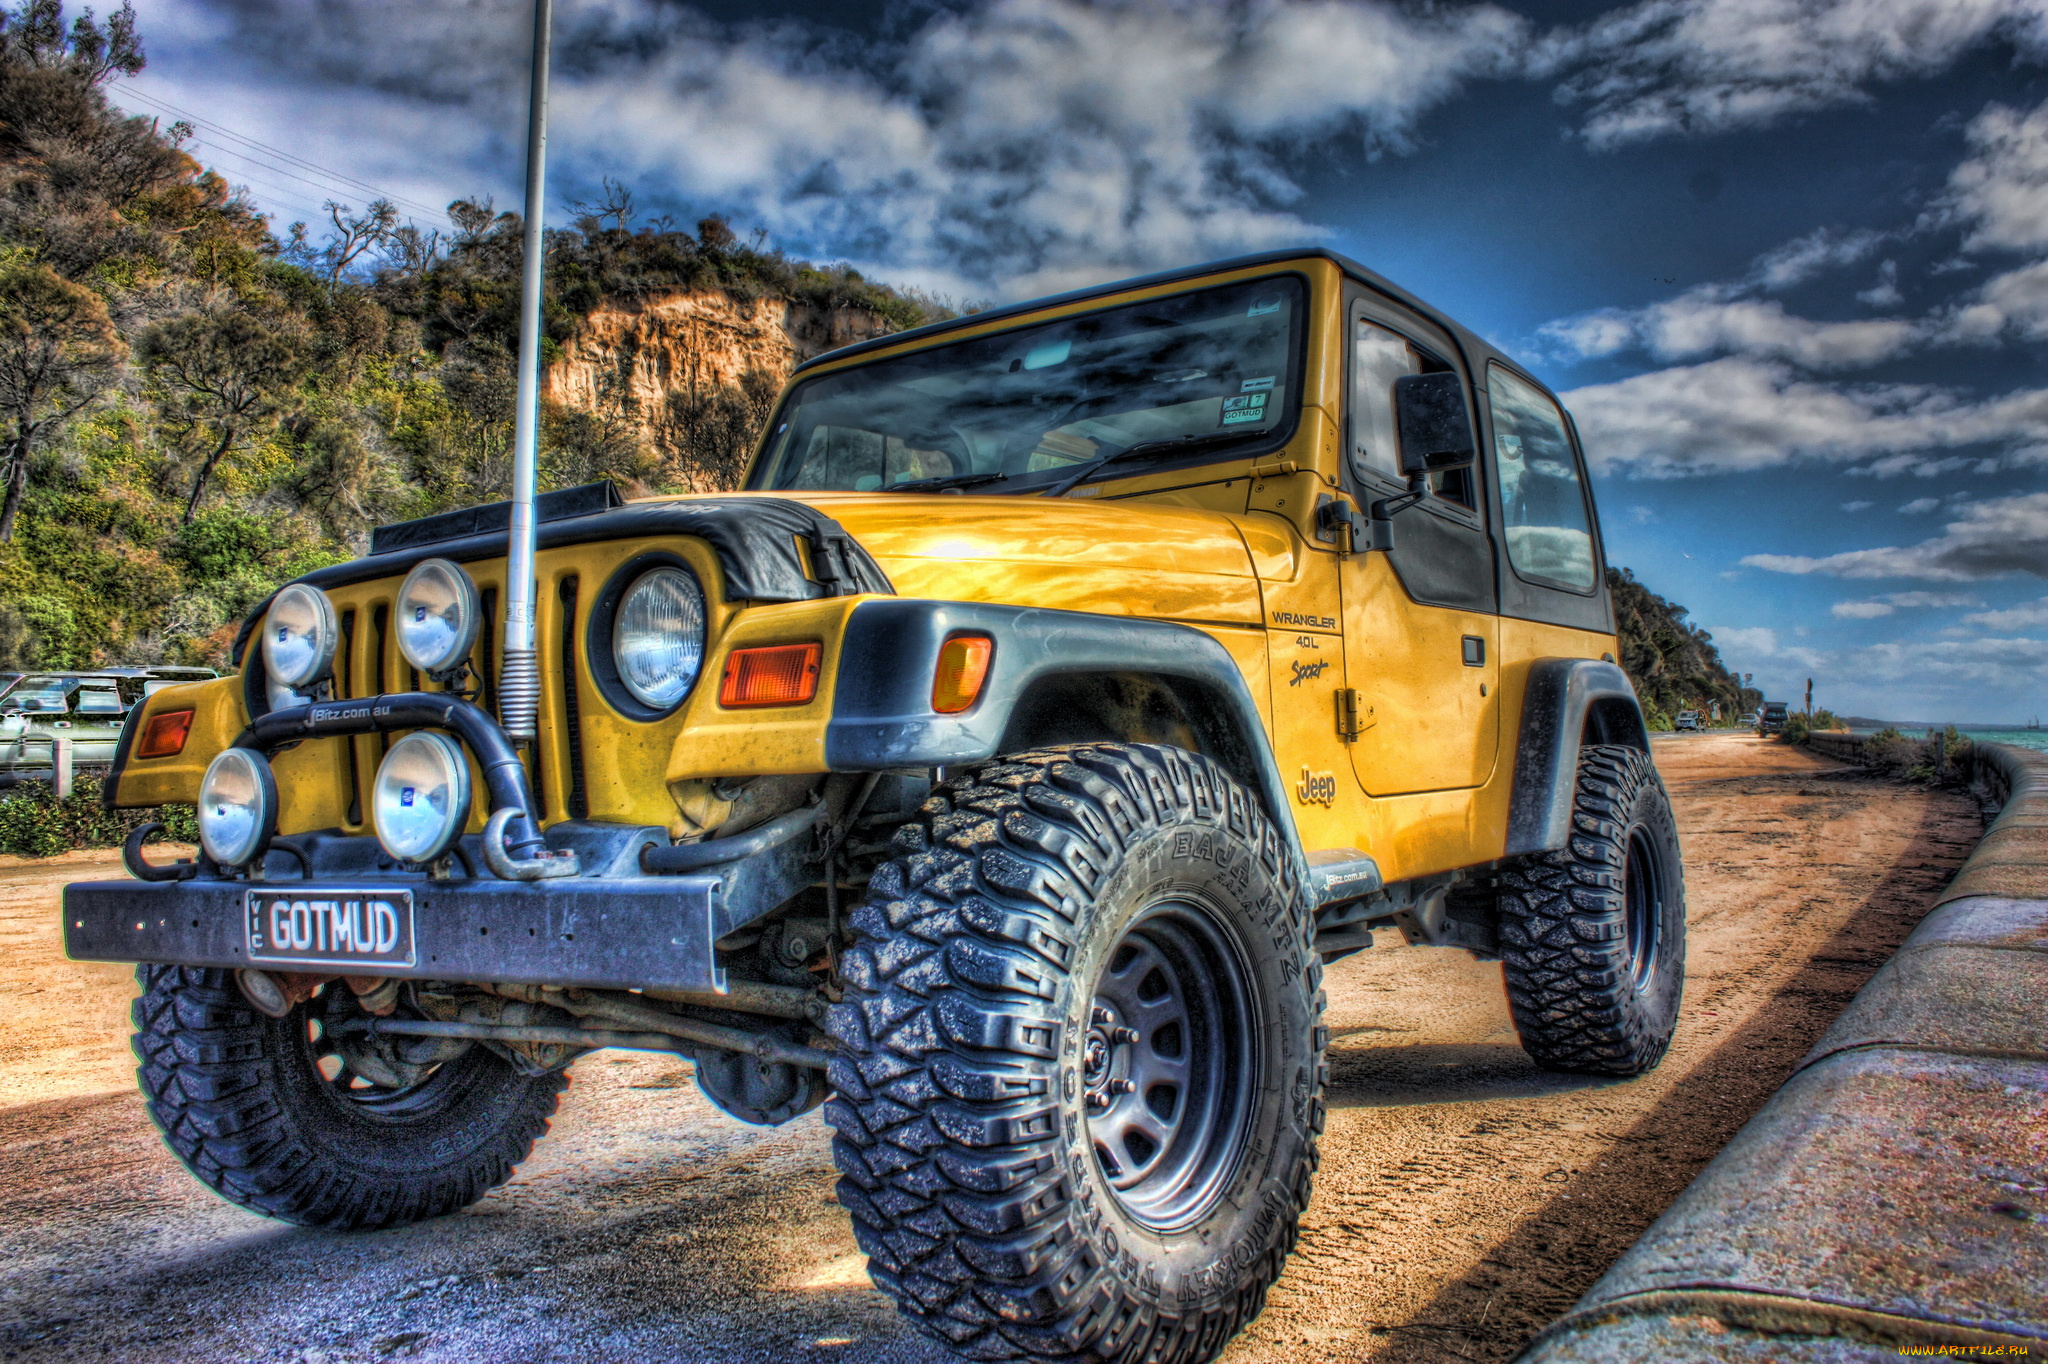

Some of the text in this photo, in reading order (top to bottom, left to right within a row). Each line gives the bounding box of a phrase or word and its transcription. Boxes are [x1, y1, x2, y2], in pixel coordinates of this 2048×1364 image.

[1225, 409, 1261, 419] GOTMUD
[1272, 611, 1336, 629] WRANGLER
[1290, 658, 1329, 688] Sport
[1299, 768, 1336, 804] Jeep
[1172, 832, 1251, 888] BAJA
[250, 901, 264, 948] VIC
[270, 900, 399, 954] GOTMUD
[1176, 1191, 1286, 1303] MICKEY
